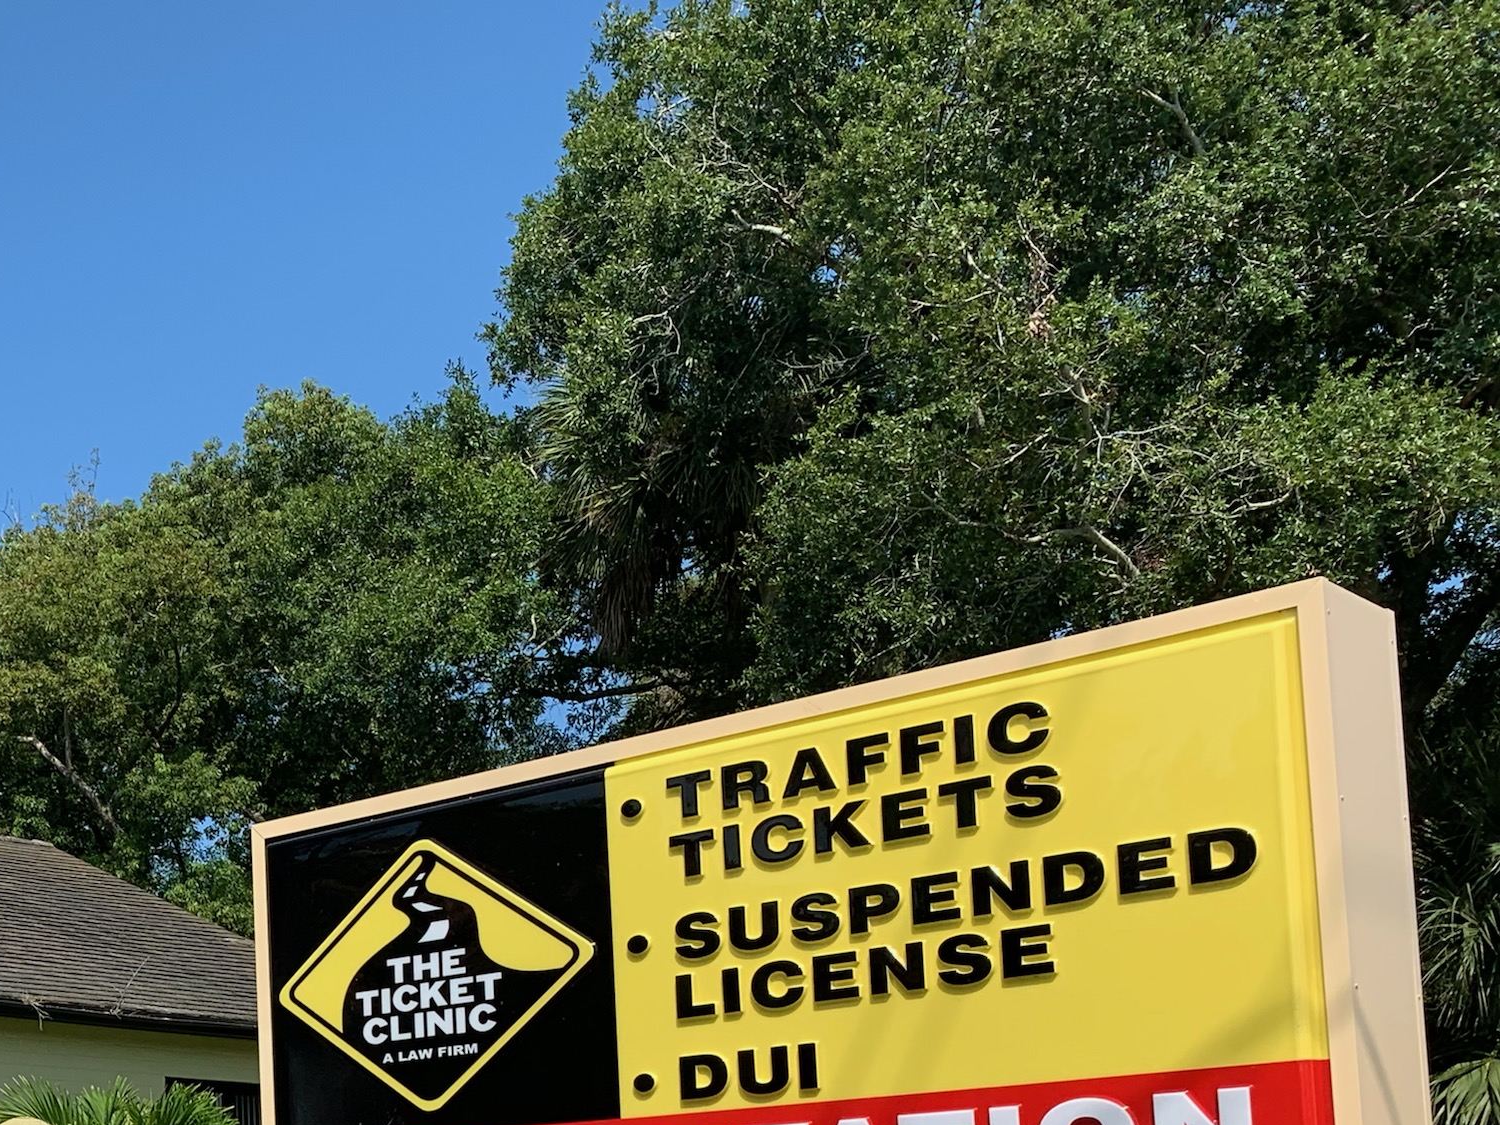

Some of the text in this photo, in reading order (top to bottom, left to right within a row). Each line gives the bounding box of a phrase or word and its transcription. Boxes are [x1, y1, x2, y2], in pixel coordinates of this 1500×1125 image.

[666, 701, 1050, 818] TRAFFIC
[669, 765, 1062, 878] TICKETS
[675, 827, 1257, 959] SUSPENDED
[355, 972, 502, 1016] TICKET
[386, 948, 466, 984] THE
[675, 924, 1055, 1019] LICENSE
[362, 1003, 497, 1045] CLINIC
[382, 1043, 479, 1064] A LAW FIRM
[679, 1042, 818, 1101] DUI
